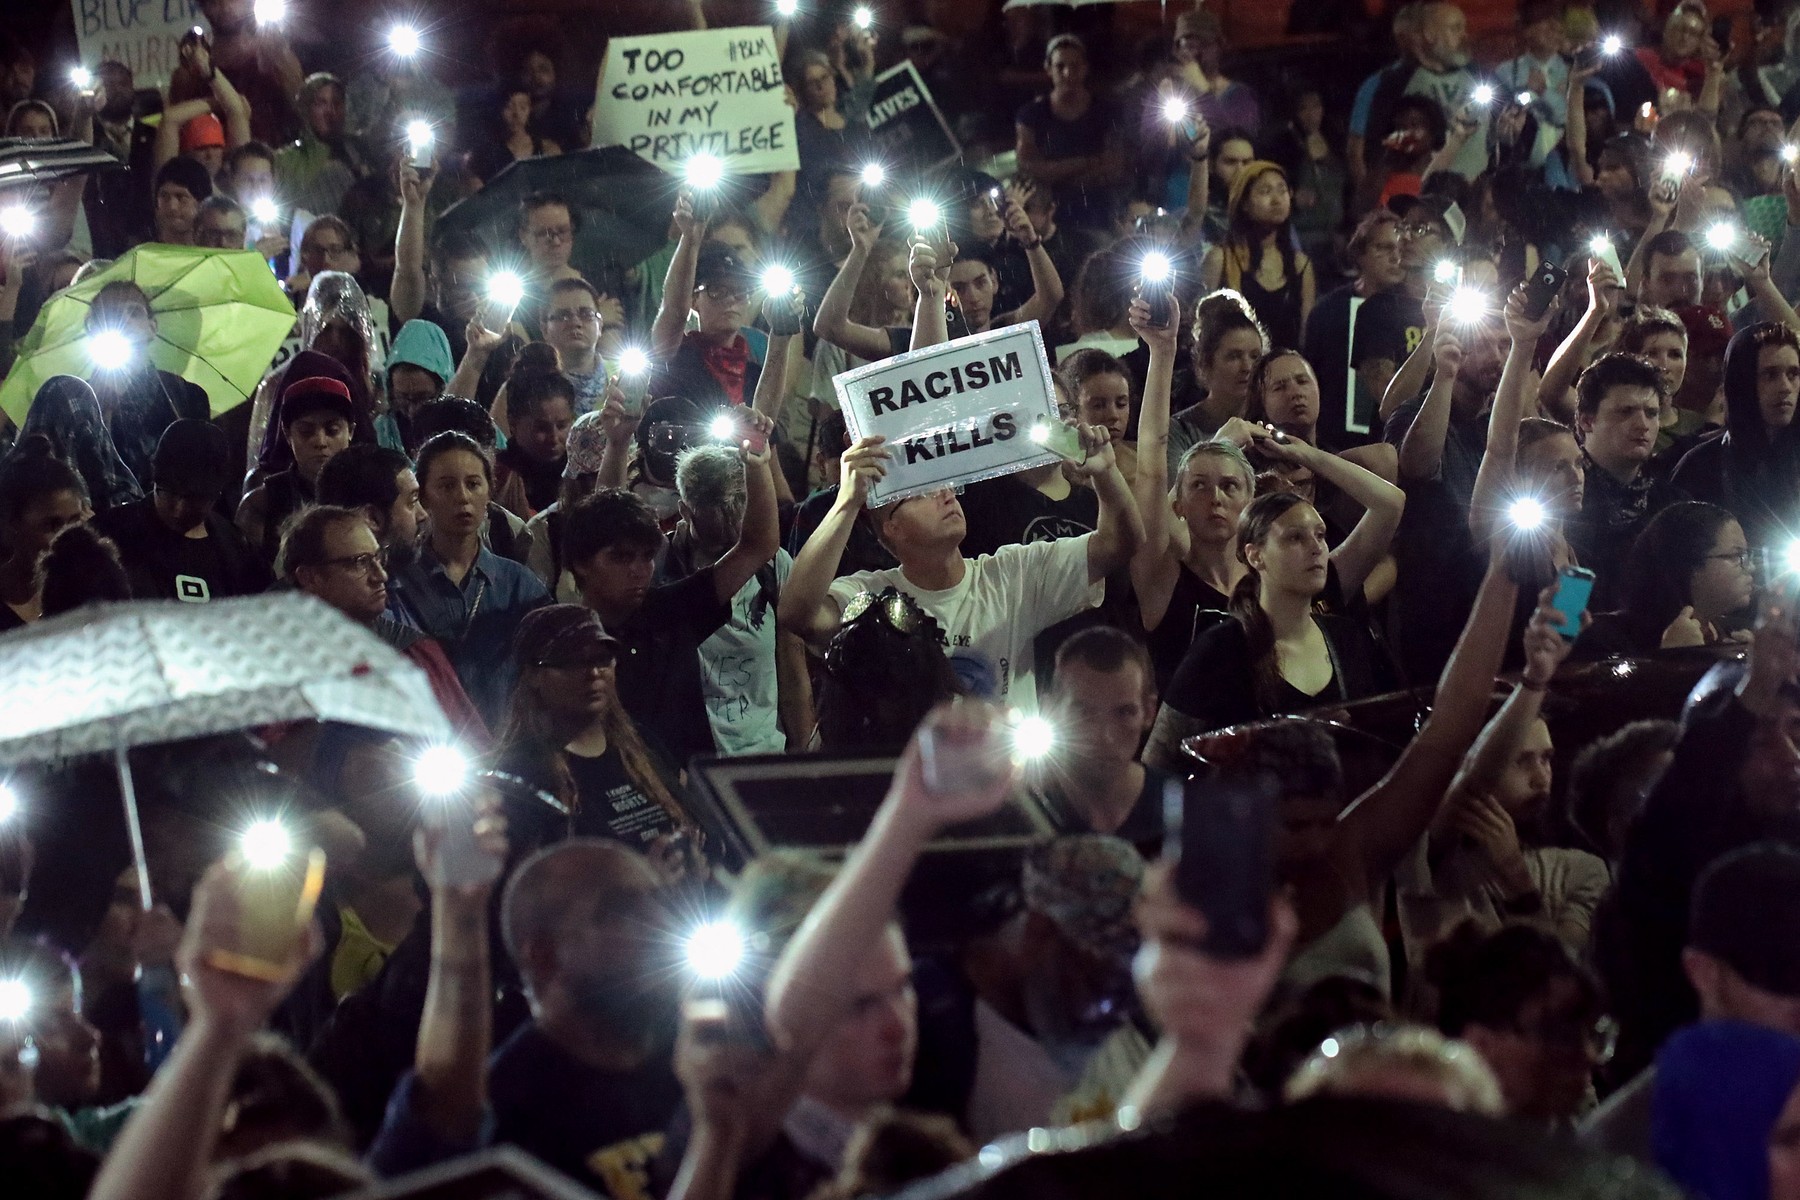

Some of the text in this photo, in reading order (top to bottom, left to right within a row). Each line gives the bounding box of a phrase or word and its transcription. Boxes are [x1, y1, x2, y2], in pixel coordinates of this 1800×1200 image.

[623, 49, 684, 75] TOO
[612, 63, 783, 101] COMFORTABLE
[648, 101, 718, 127] IN MY
[630, 122, 784, 161] PRIVILEGE
[868, 351, 1023, 416] RACISM
[903, 412, 1018, 465] KILLS
